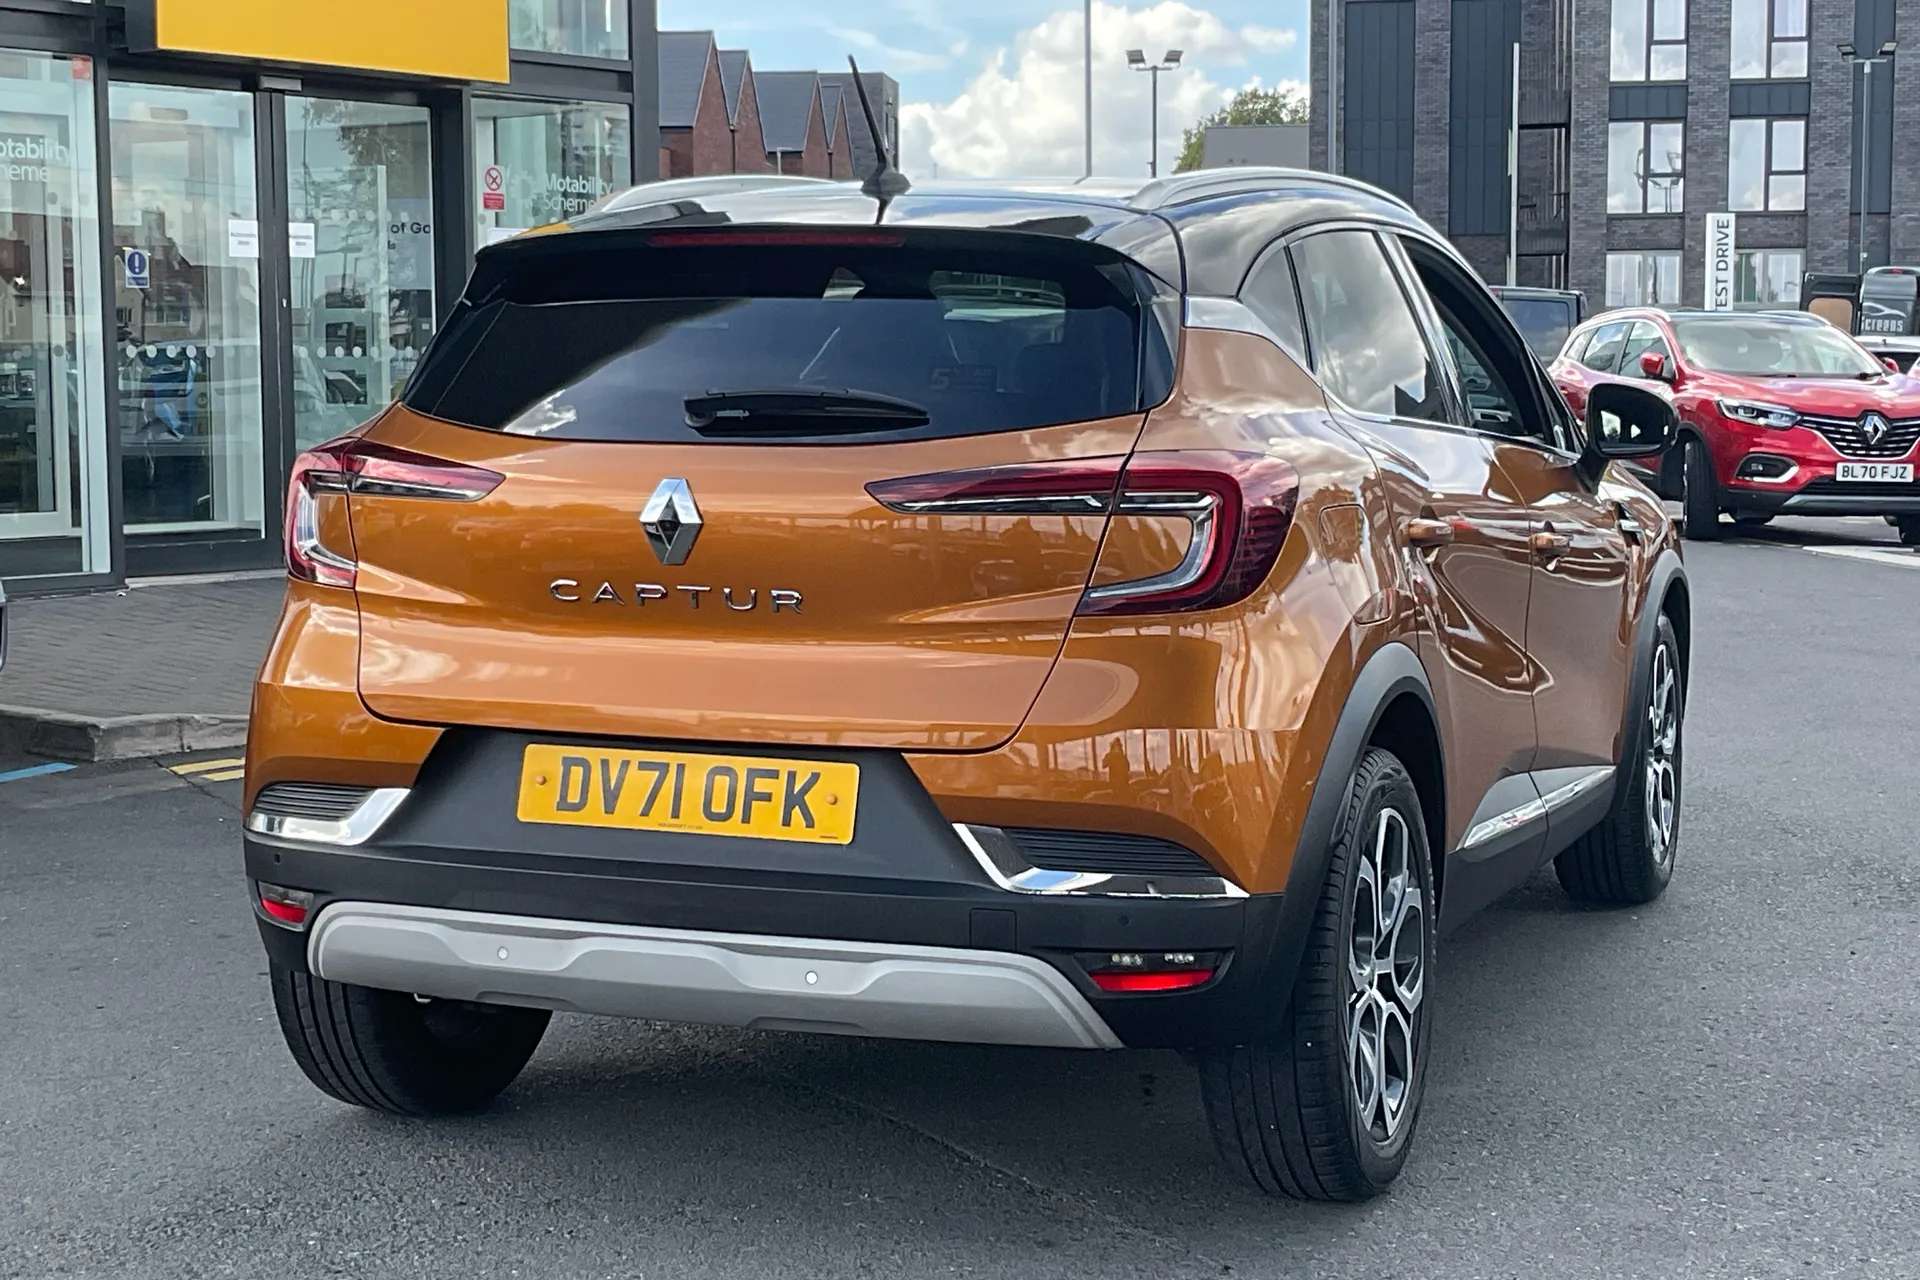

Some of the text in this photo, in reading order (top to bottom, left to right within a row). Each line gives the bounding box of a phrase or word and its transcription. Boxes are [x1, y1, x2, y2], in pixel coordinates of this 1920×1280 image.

[543, 173, 613, 197] Motability
[1715, 219, 1730, 311] EST DRIVE
[1841, 465, 1908, 479] BL70 FJZ
[549, 578, 803, 615] CAPTUR
[556, 756, 822, 829] DV71 OFK
